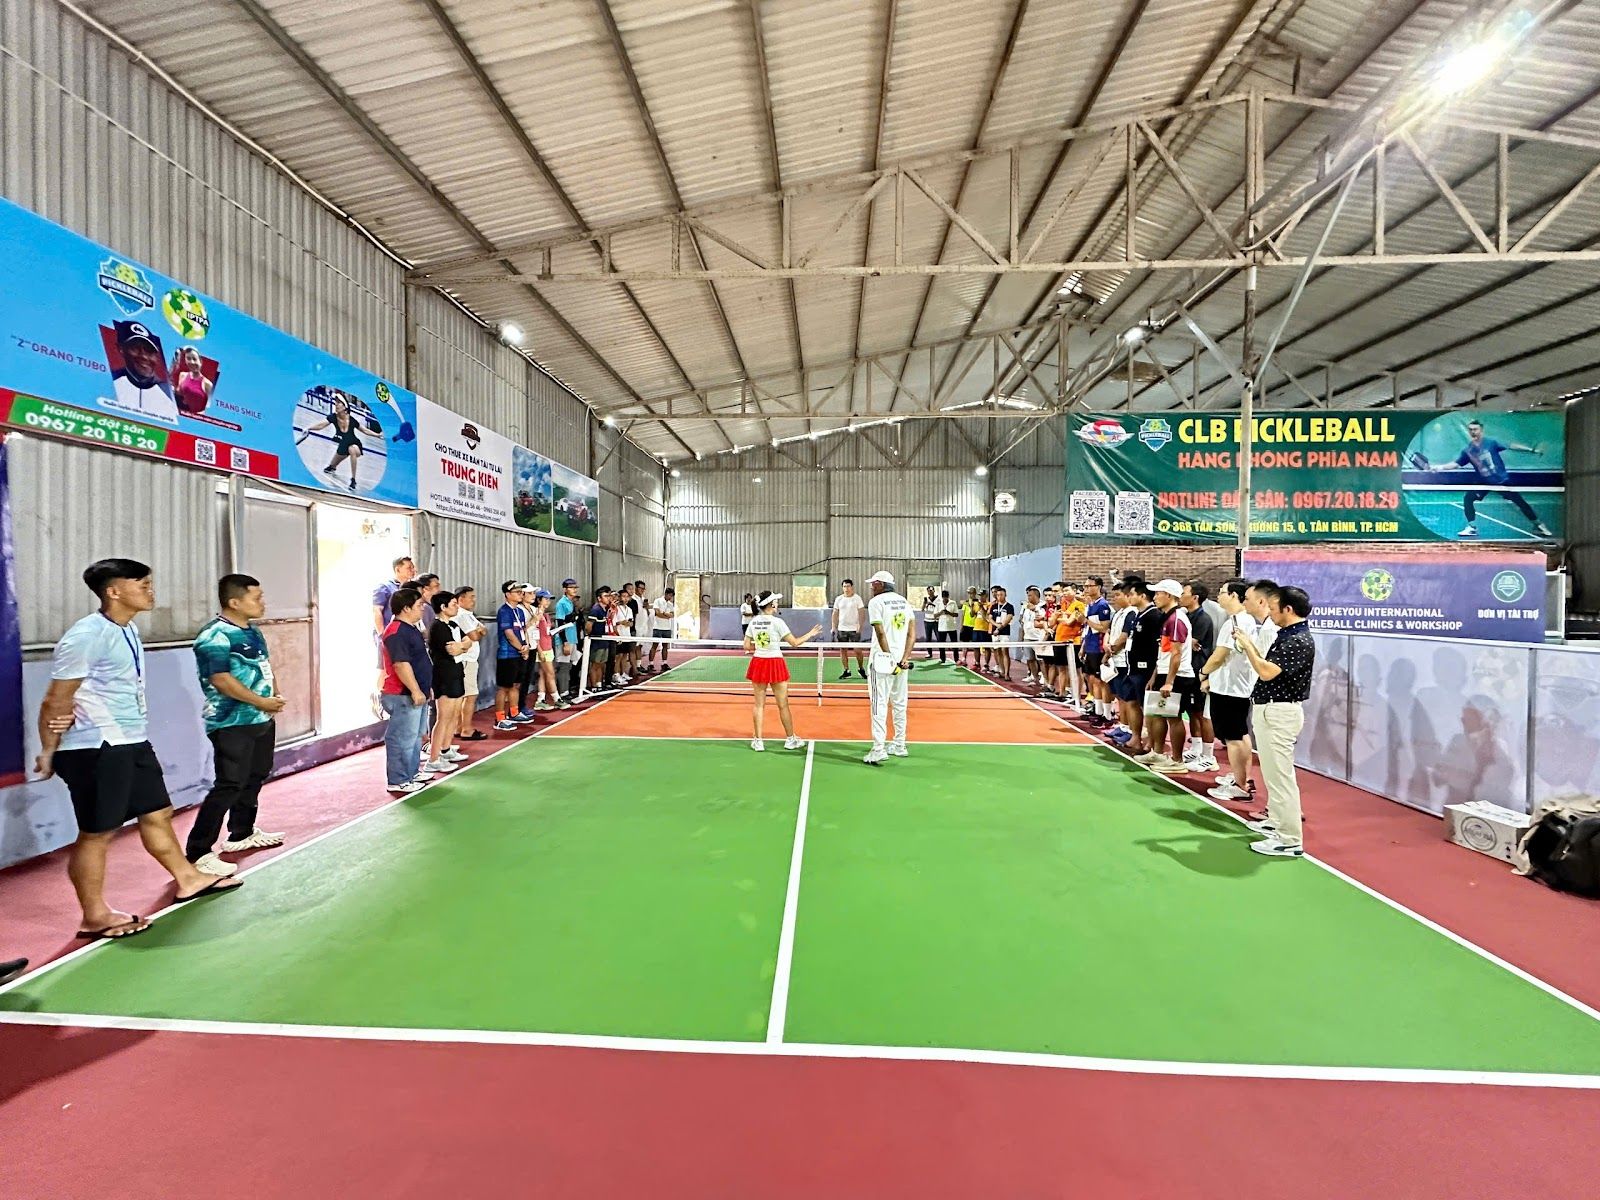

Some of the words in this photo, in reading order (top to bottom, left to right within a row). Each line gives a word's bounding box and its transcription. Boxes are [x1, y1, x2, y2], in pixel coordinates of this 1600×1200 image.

[186, 312, 210, 327] IPTPA
[76, 356, 107, 373] TUBO
[42, 404, 94, 423] Hotline
[123, 423, 146, 436] sân
[241, 407, 262, 420] SMILE
[25, 412, 77, 433] 0967
[82, 425, 106, 440] 20
[111, 430, 132, 445] 18
[136, 437, 158, 451] 20
[1178, 418, 1227, 444] CLB
[434, 442, 448, 454] CHO
[1354, 450, 1398, 468] NAM
[440, 458, 476, 484] TRUNG
[1157, 491, 1218, 509] HOTLINE
[1254, 488, 1288, 509] SÂN:
[1292, 491, 1399, 509] 0967.20.18.20
[1281, 521, 1296, 534] 15,
[1297, 521, 1308, 533] Q.
[1309, 519, 1329, 533] TÂN
[1359, 521, 1374, 533] TP.
[1375, 521, 1399, 533] HCM
[1363, 607, 1444, 618] INTERNATIONAL
[1307, 618, 1353, 629] KLEBALL
[1354, 619, 1394, 630] CLINICS
[1395, 620, 1404, 630] &
[1404, 620, 1464, 631] WORKSHOP
